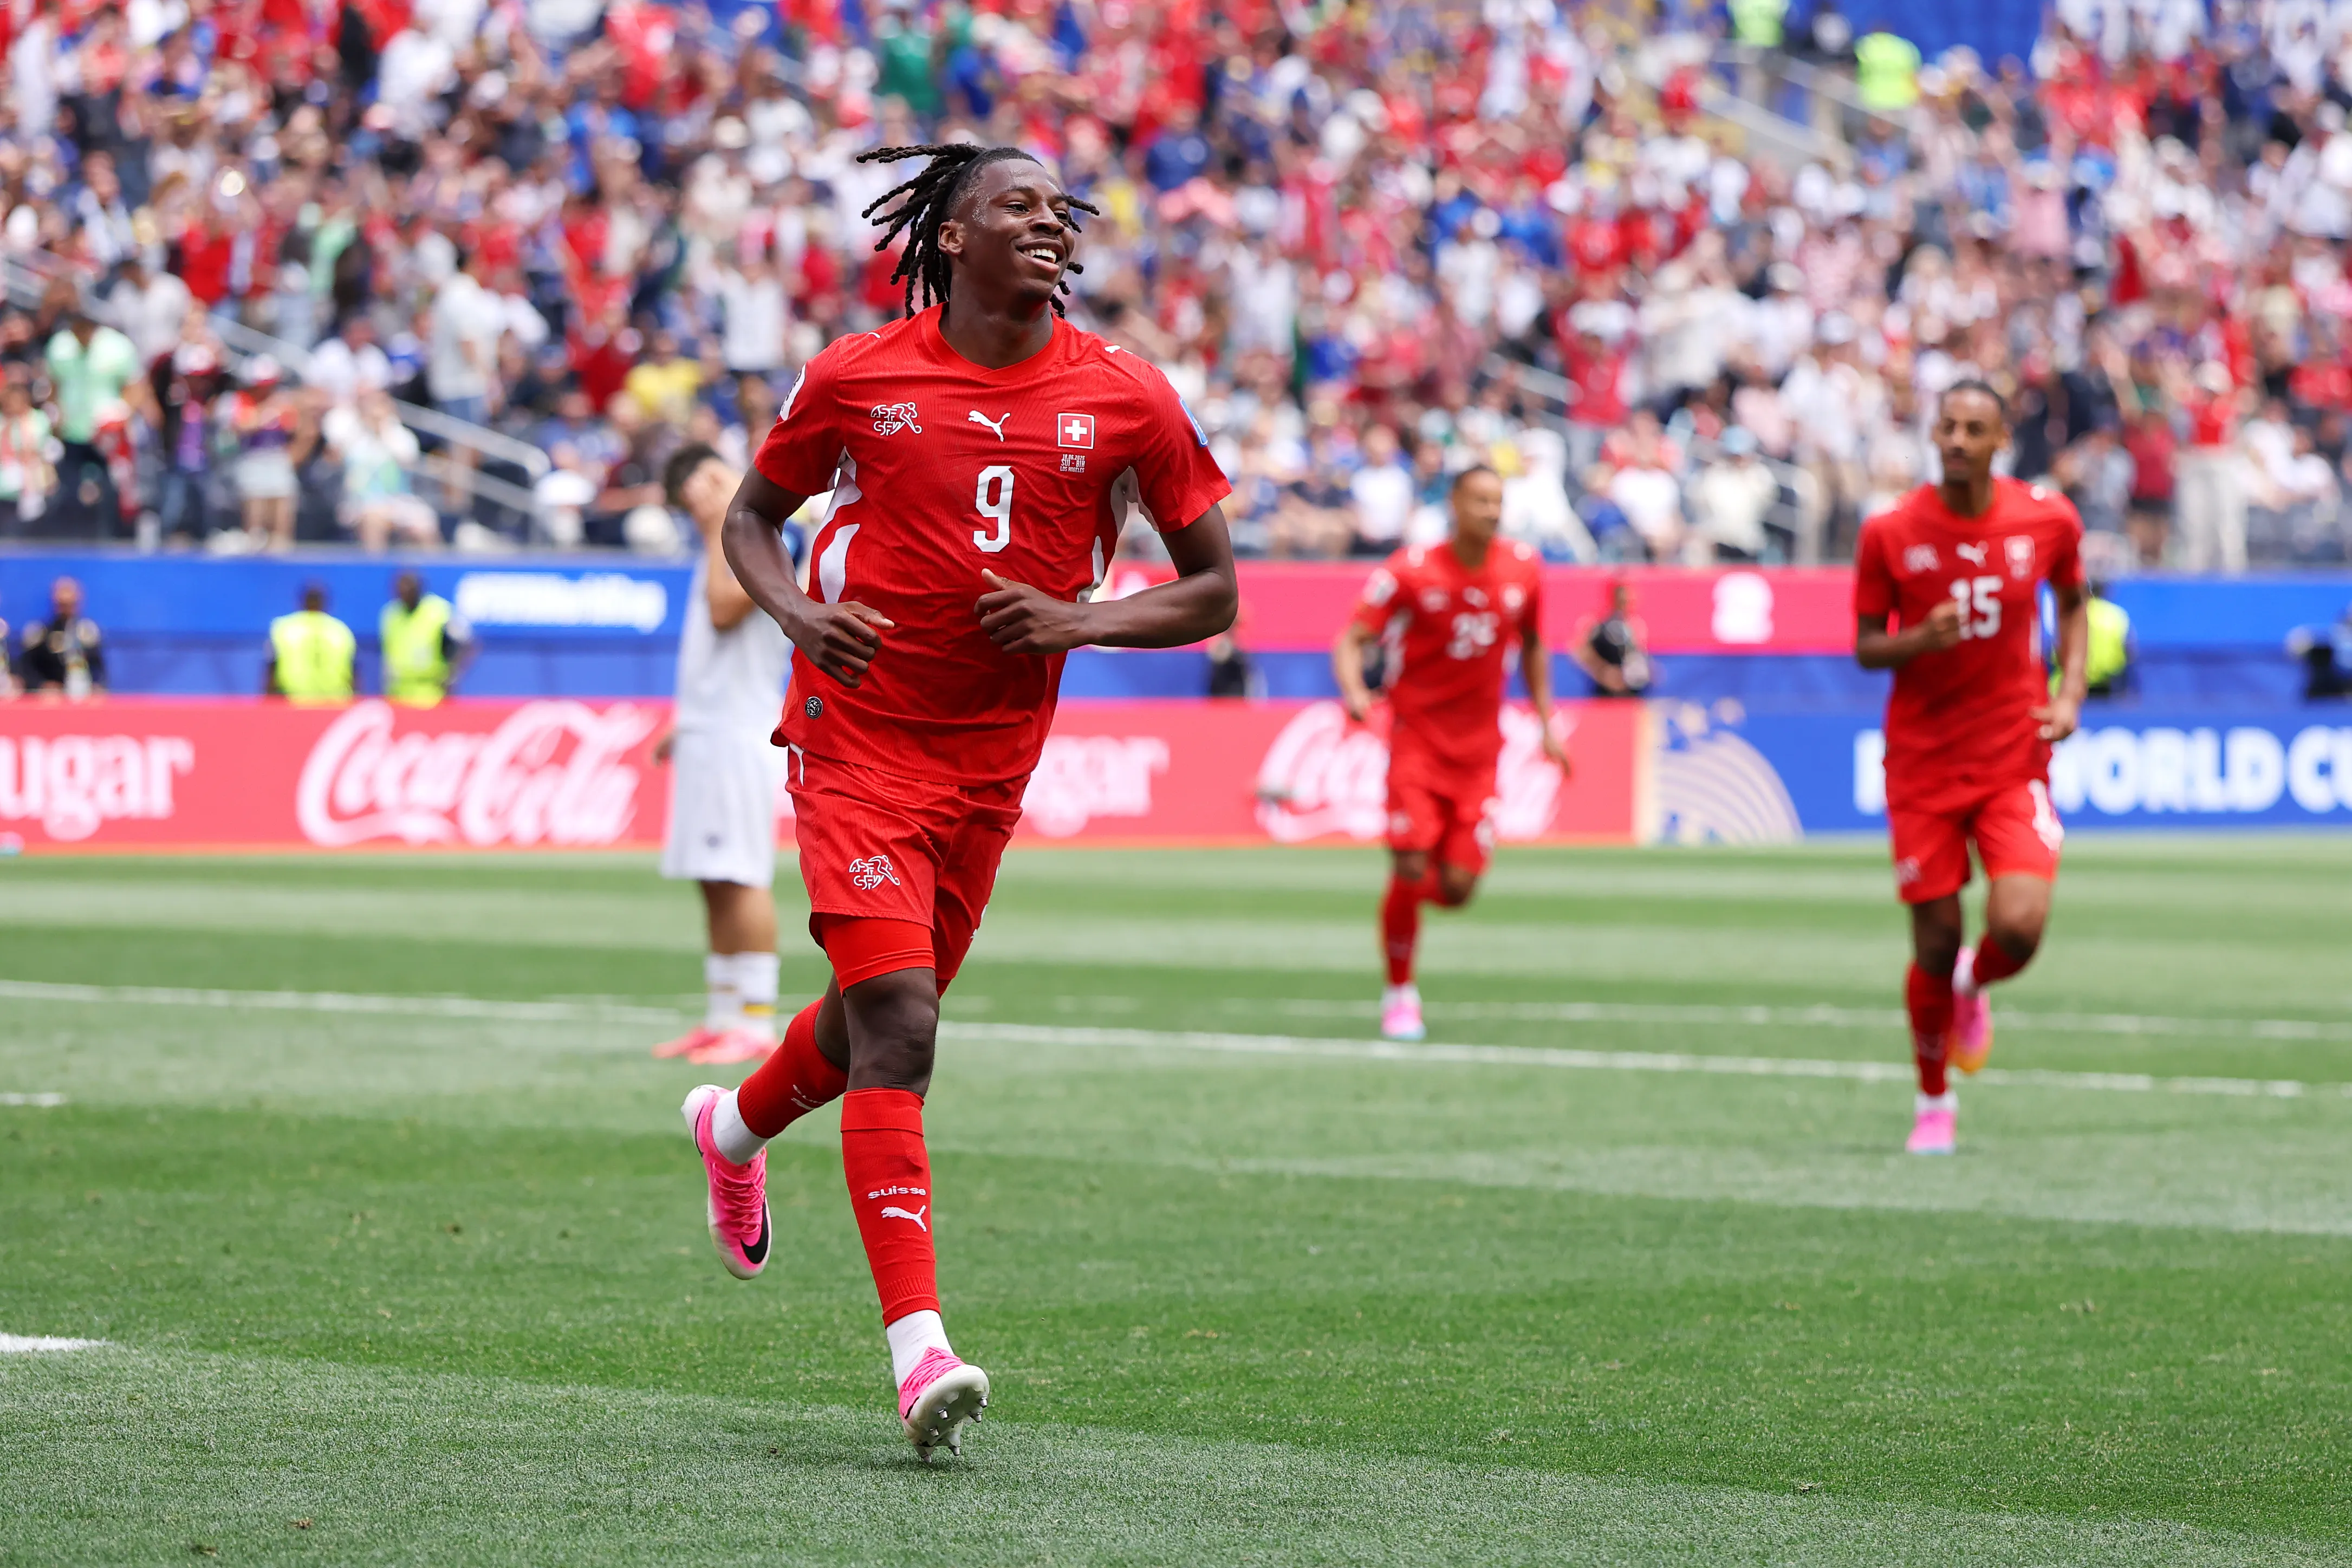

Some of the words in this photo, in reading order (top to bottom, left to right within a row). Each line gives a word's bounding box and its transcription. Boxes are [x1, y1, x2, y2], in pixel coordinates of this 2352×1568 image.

[1061, 459, 1070, 467] SUI
[1076, 460, 1086, 468] BIH
[973, 466, 1015, 552] 9
[1950, 575, 2004, 640] 15
[868, 1185, 926, 1199] suisse
